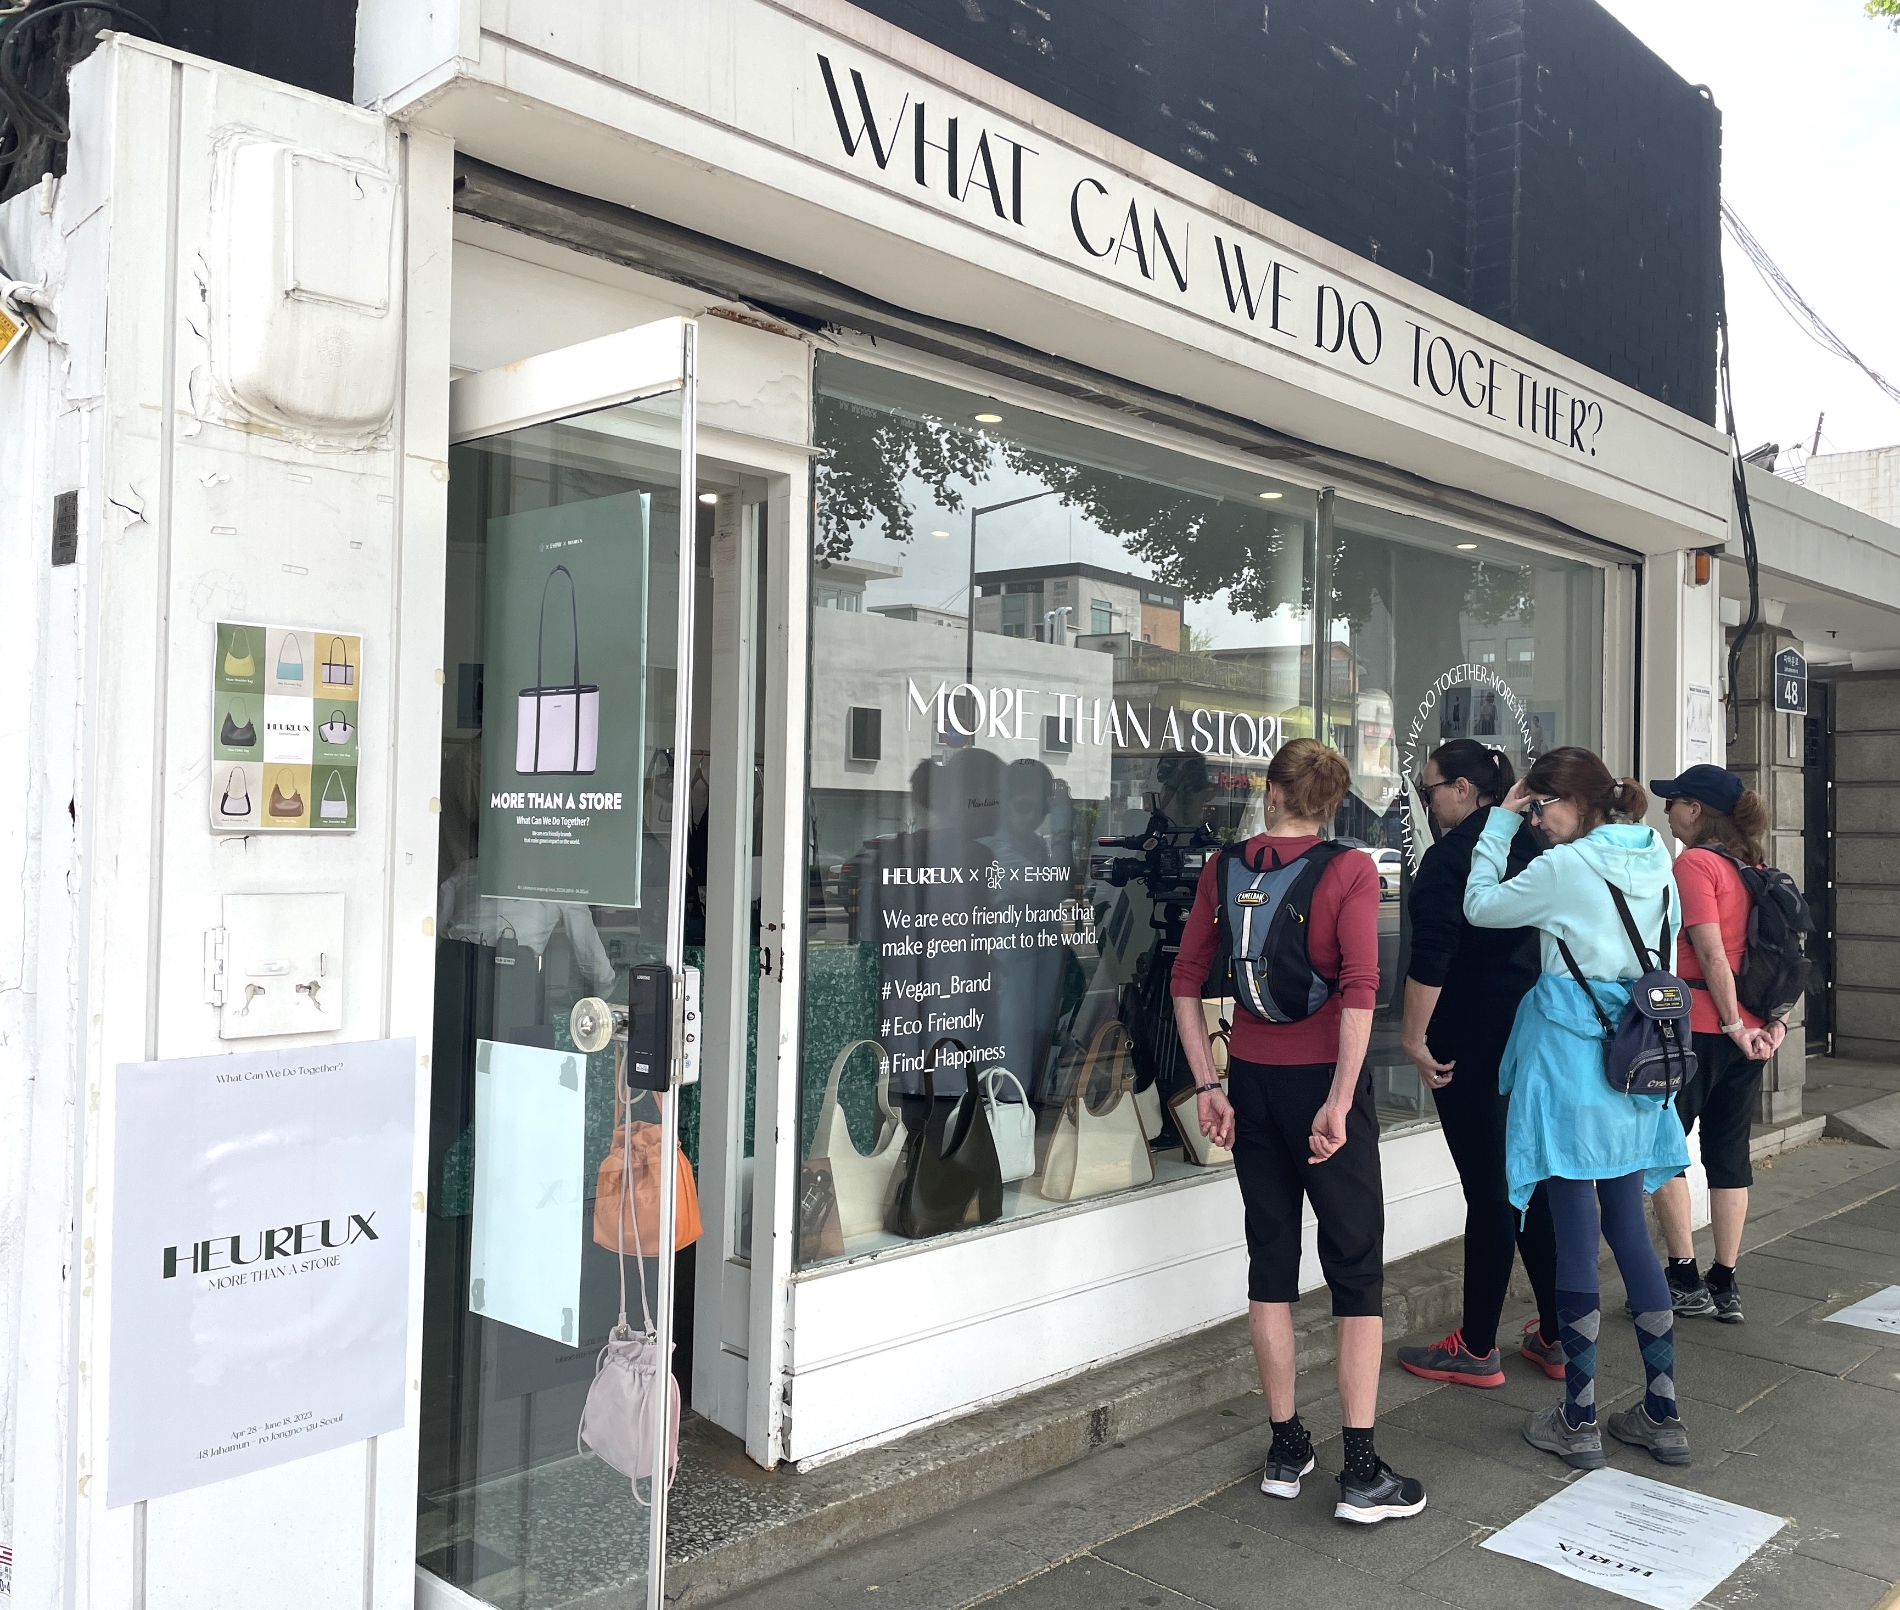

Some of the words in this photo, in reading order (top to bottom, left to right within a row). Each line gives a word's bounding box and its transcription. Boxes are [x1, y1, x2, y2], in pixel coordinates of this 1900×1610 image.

[817, 53, 1039, 227] WHAT
[1070, 177, 1189, 292] CAN
[1214, 236, 1298, 338] WE
[1314, 284, 1382, 365] DO
[1405, 320, 1603, 456] TOGETHER?
[1784, 680, 1798, 705] 48
[907, 677, 1039, 741] MORE
[1048, 692, 1152, 749] THAN
[1160, 705, 1184, 752] A
[1406, 715, 1424, 747] WE
[1419, 690, 1435, 720] DO
[490, 792, 525, 809] MORE
[527, 792, 563, 810] THAN
[565, 793, 575, 810] A
[579, 793, 622, 810] STORE
[516, 815, 530, 825] What
[531, 816, 542, 825] Can
[542, 816, 551, 825] We
[552, 817, 560, 825] Do
[561, 816, 590, 829] Together?
[882, 867, 964, 885] HEUREUX
[882, 909, 911, 929] We
[914, 912, 938, 928] are
[941, 911, 968, 926] eco
[972, 904, 1022, 928] friendly
[1025, 903, 1068, 923] brands
[1071, 902, 1095, 921] that
[882, 935, 923, 957] make
[926, 936, 967, 959] green
[970, 933, 1016, 955] impact
[1020, 933, 1034, 948] to
[1037, 928, 1058, 947] the
[1060, 926, 1099, 946] world.
[928, 1008, 984, 1032] Friendly
[216, 1073, 242, 1084] What
[244, 1070, 264, 1081] Can
[265, 1068, 281, 1079] We
[282, 1067, 296, 1077] Do
[298, 1062, 344, 1076] Together?
[163, 1210, 379, 1279] HEUREUX
[208, 1273, 248, 1291] MORE
[250, 1266, 287, 1283] THAN
[288, 1264, 298, 1275] A
[300, 1255, 341, 1273] STORE
[210, 1441, 250, 1457] Jahamun
[258, 1436, 269, 1445] ro
[320, 1413, 344, 1428] Seoul
[230, 1429, 246, 1440] Apr
[247, 1425, 257, 1434] 28
[264, 1420, 282, 1432] June
[293, 1411, 313, 1422] 2023
